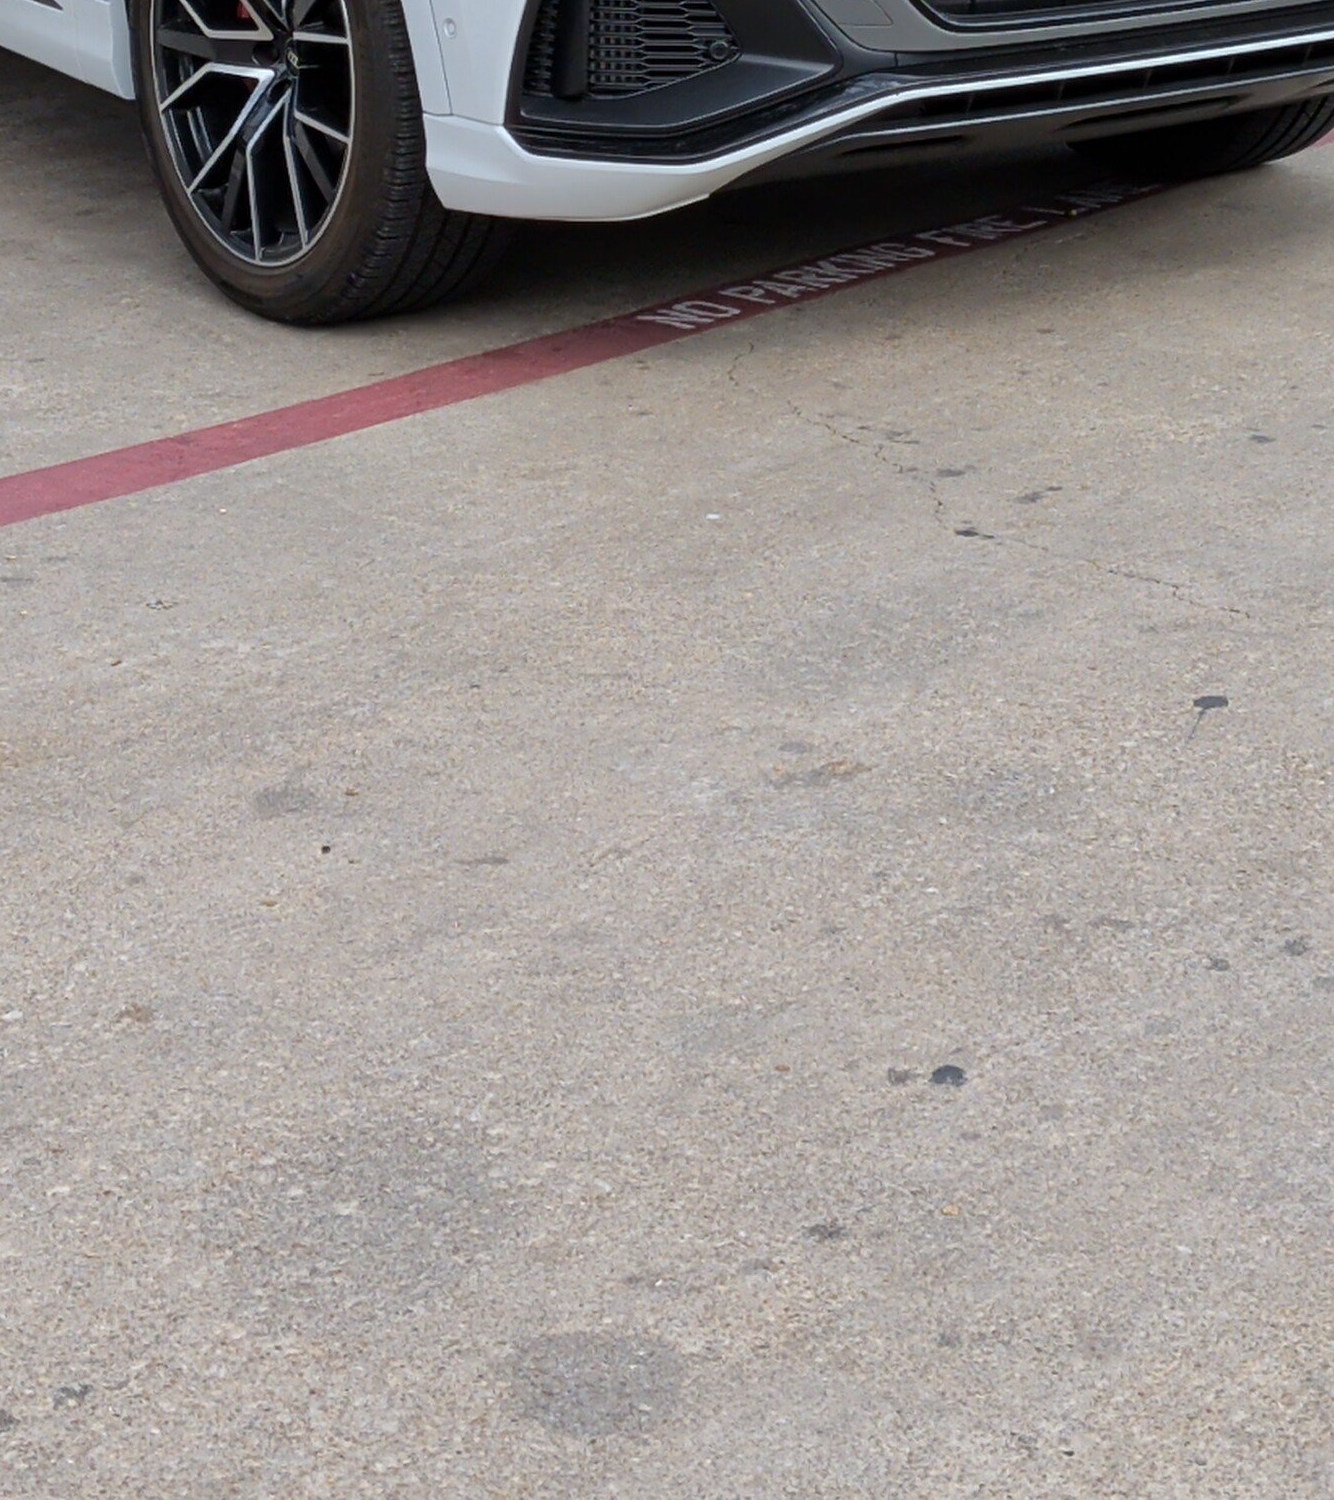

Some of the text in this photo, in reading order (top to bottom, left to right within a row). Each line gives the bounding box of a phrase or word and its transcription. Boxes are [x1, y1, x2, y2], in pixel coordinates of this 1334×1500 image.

[636, 300, 741, 330] NO
[719, 242, 936, 305] PARKING
[915, 213, 1049, 248] FIRE
